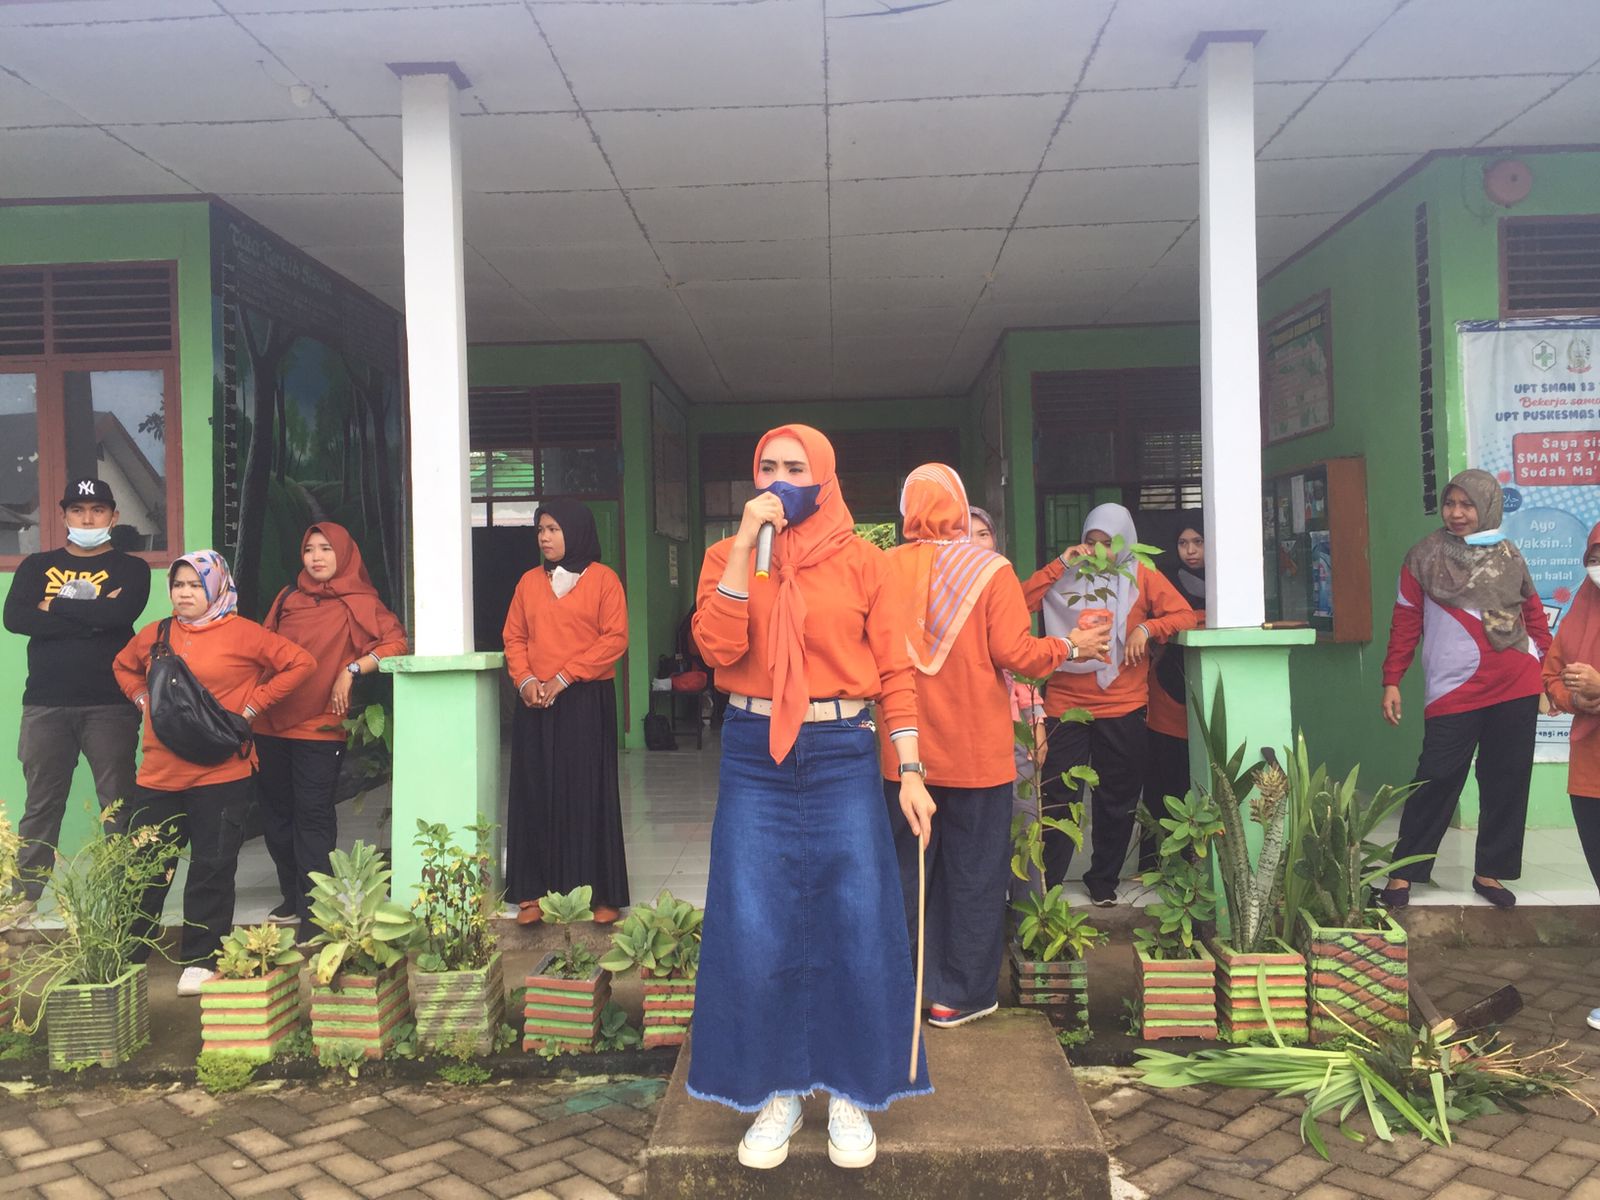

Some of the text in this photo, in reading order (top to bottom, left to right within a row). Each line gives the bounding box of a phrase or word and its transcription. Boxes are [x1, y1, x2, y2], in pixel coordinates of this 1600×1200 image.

[1514, 382, 1595, 394] UPT SMAN 13
[1519, 396, 1569, 408] Bekerja
[1495, 409, 1595, 422] UPT PUSKESMAS
[1542, 438, 1578, 450] Saya
[1517, 452, 1560, 464] SMAN
[1566, 452, 1582, 462] 13
[1520, 466, 1566, 478] Sudah
[78, 480, 95, 495] NY
[1530, 519, 1556, 533] Ayo
[1550, 558, 1580, 566] aman
[1545, 571, 1573, 581] halal
